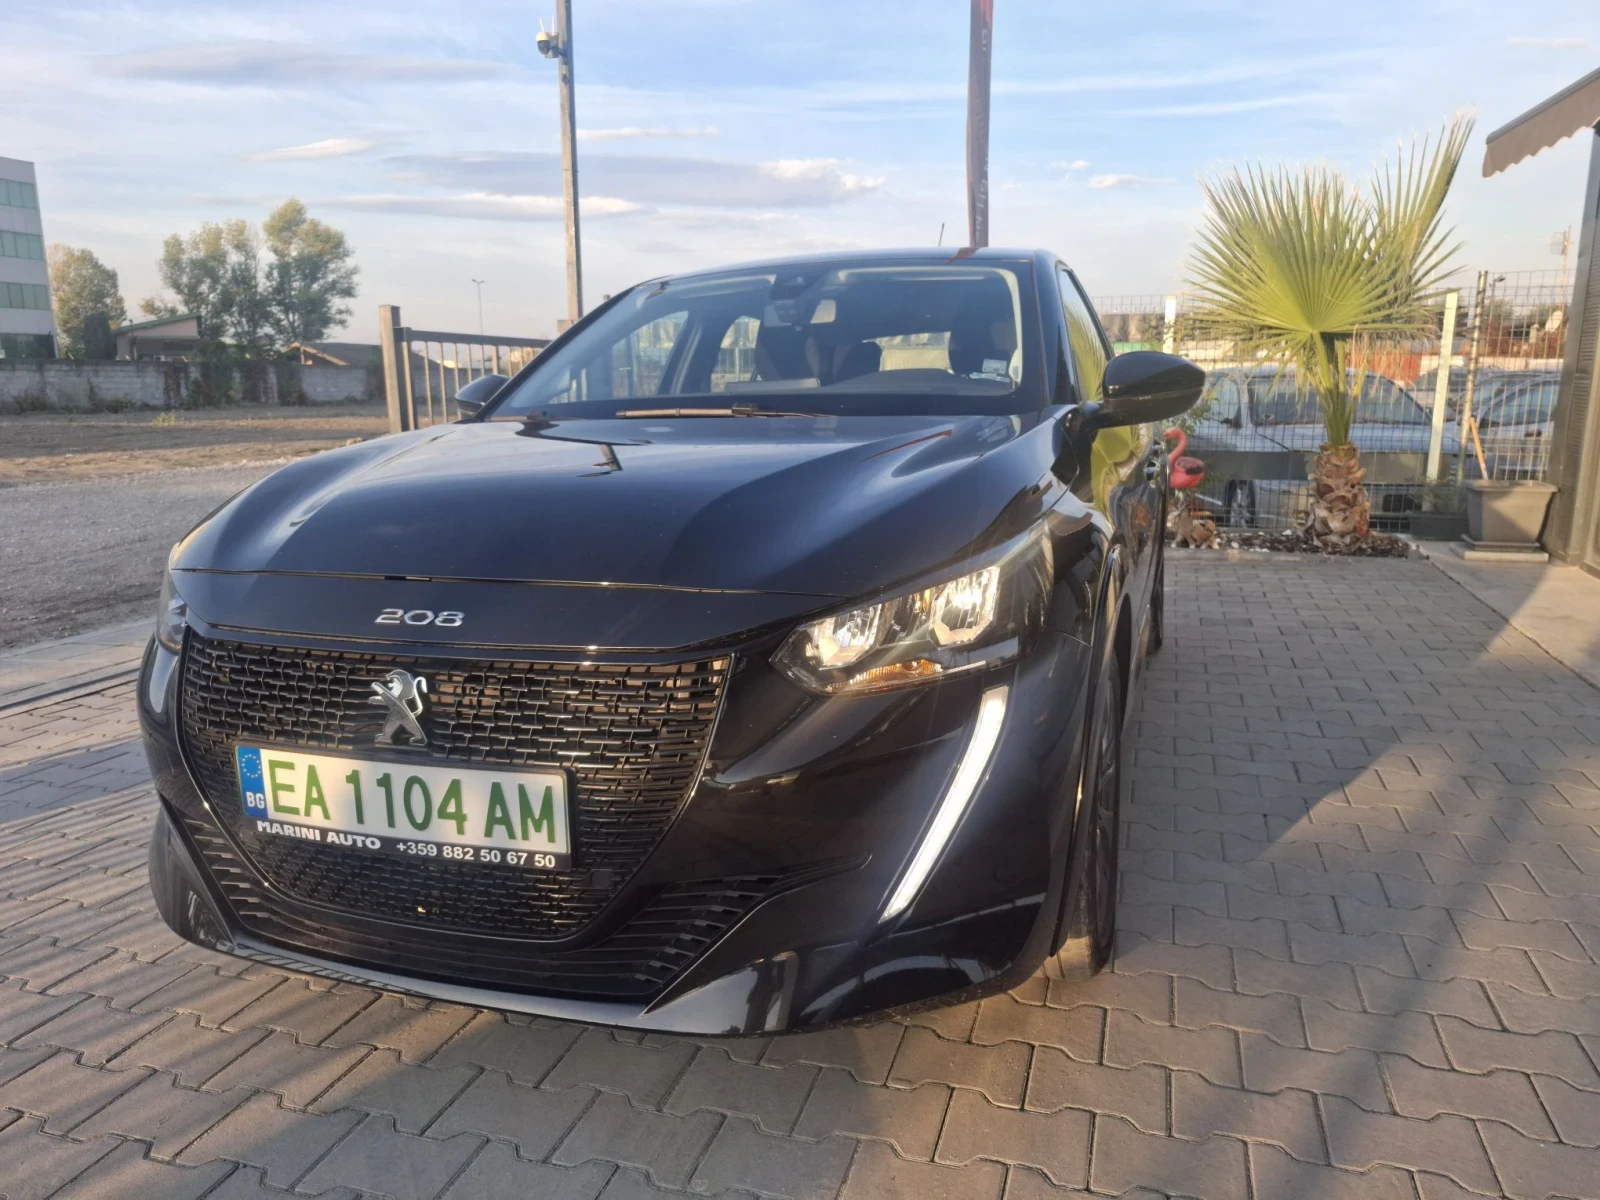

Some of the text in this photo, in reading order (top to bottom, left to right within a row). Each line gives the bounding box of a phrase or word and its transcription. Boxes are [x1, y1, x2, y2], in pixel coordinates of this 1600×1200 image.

[375, 609, 465, 627] 208
[246, 791, 265, 810] BG
[267, 759, 556, 844] EA 1104 AM
[257, 820, 556, 868] MARINI AUTO +359 882 50 67 50
